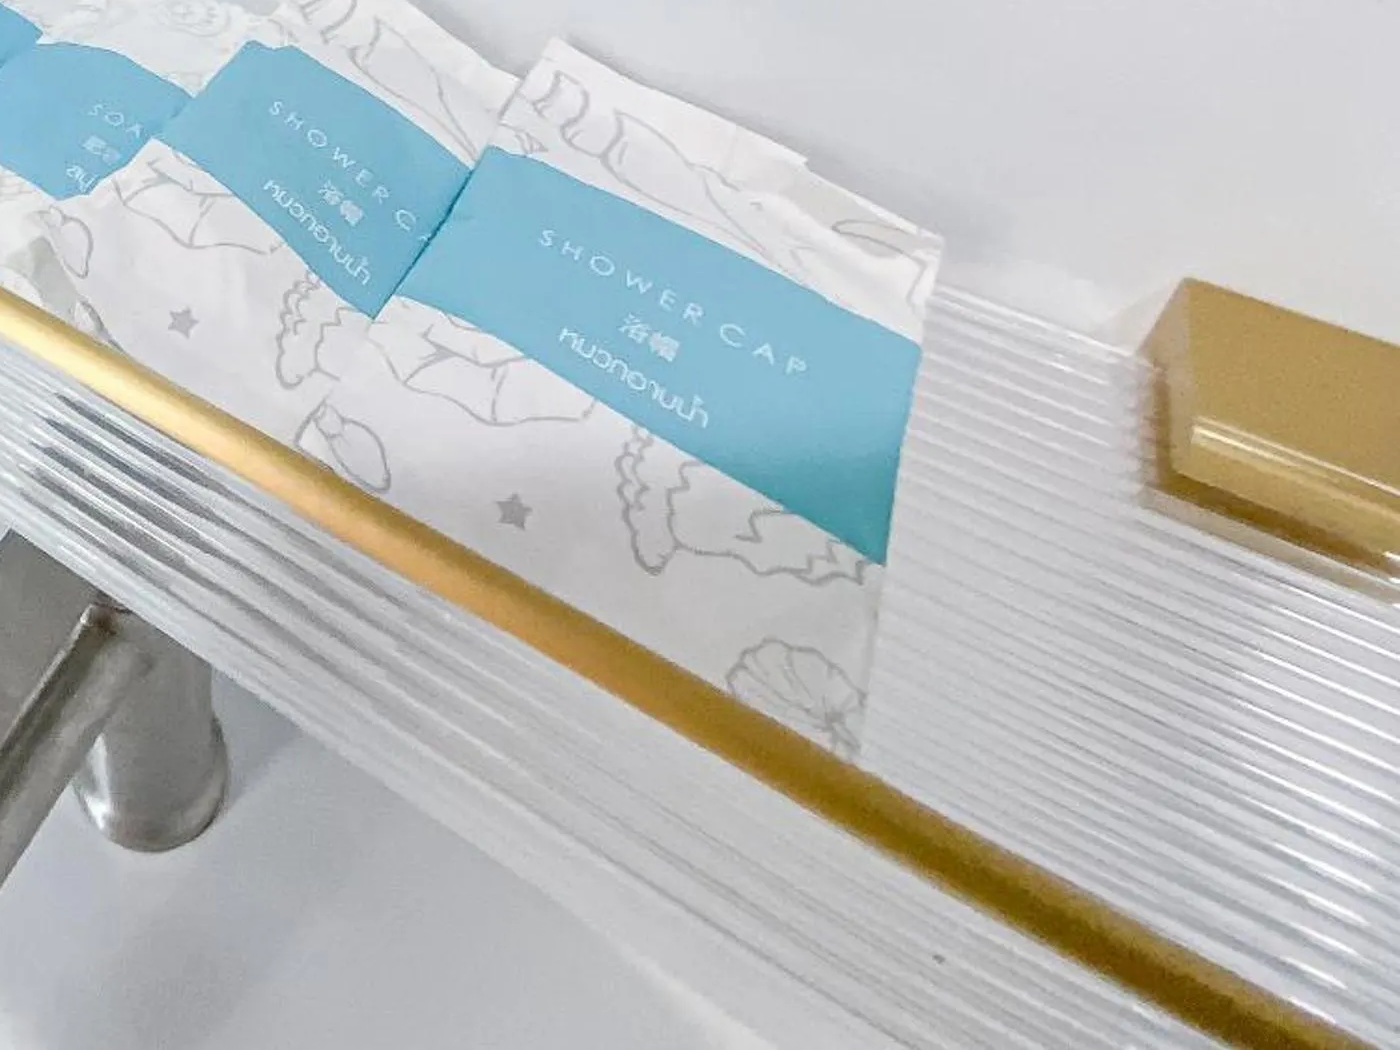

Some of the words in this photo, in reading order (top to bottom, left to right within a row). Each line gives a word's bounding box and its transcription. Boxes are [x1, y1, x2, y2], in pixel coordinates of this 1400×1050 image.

[88, 103, 142, 139] SOA
[269, 101, 389, 203] SHOWER
[538, 229, 704, 326] SHOWER
[719, 323, 807, 374] CAP
